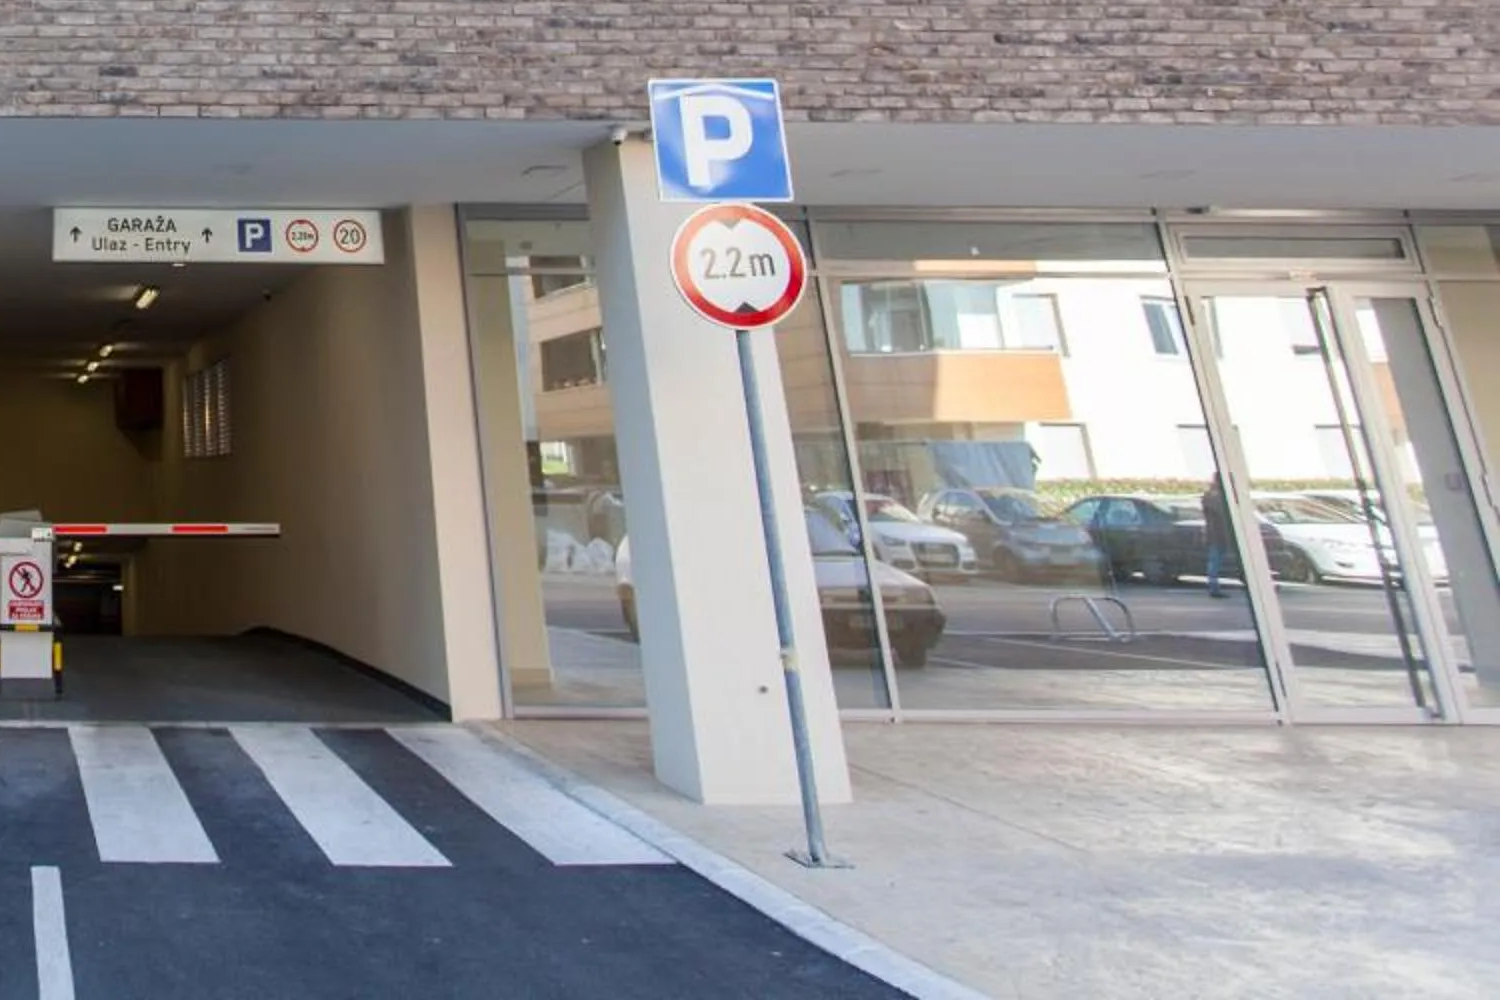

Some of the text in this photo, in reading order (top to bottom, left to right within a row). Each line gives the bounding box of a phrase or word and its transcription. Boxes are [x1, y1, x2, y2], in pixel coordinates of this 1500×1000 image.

[679, 92, 753, 187] P
[107, 215, 177, 232] GARAŽA
[245, 223, 264, 249] P
[339, 227, 360, 244] 20
[92, 236, 127, 251] Ulaz
[145, 237, 191, 255] Entry
